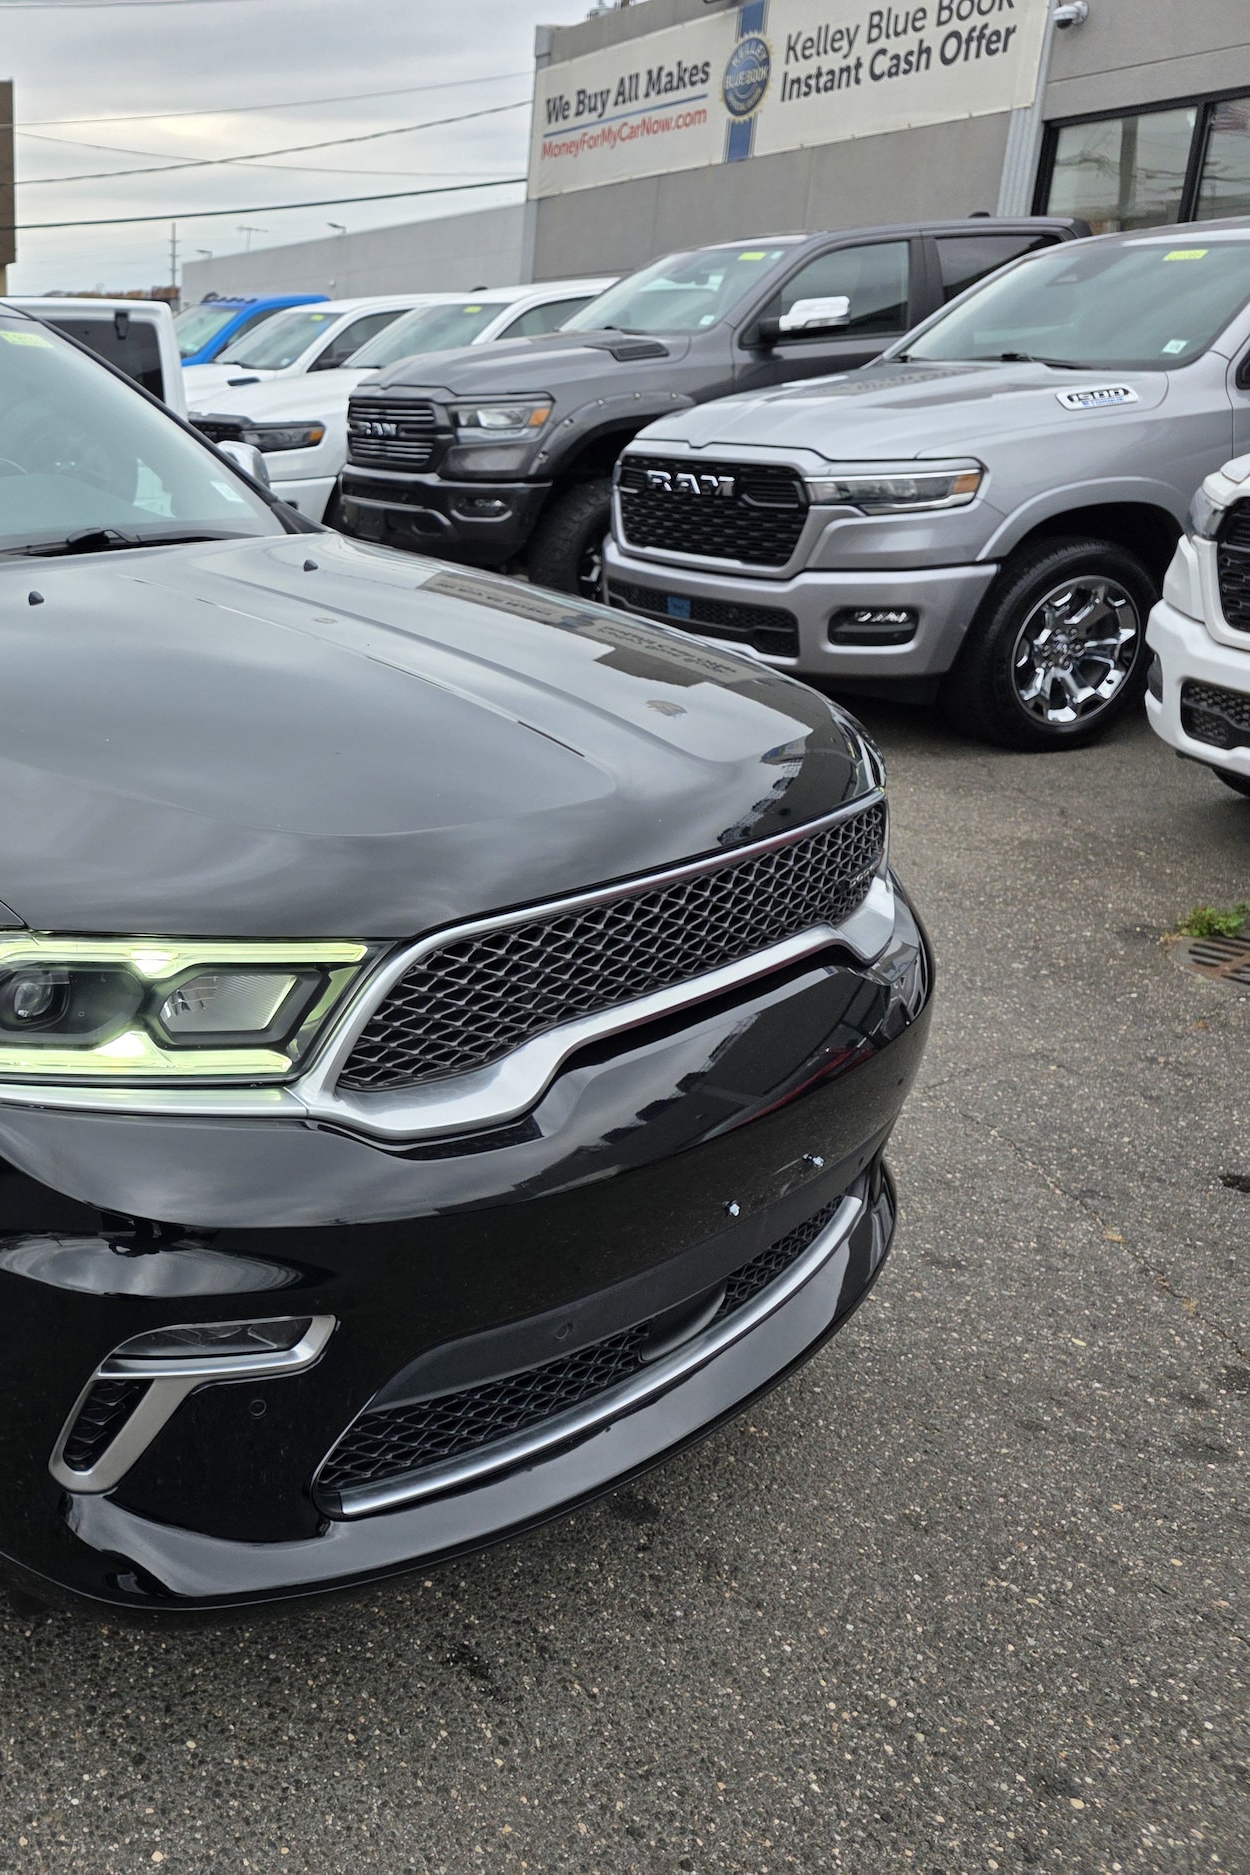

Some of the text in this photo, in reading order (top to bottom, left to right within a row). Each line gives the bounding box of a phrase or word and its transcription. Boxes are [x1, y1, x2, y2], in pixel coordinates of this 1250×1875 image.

[779, 56, 863, 102] Instant
[868, 38, 932, 82] Cash
[940, 23, 1017, 67] Offer
[785, 23, 860, 65] Kelley
[866, 7, 927, 44] Blue
[545, 94, 571, 125] We
[575, 88, 612, 119] Buy
[613, 72, 640, 107] All
[644, 60, 711, 99] Makes
[540, 108, 708, 161] MoneyForMyCarNow.com
[1067, 387, 1125, 403] 1500
[358, 420, 398, 437] RAM
[646, 469, 735, 497] RAM
